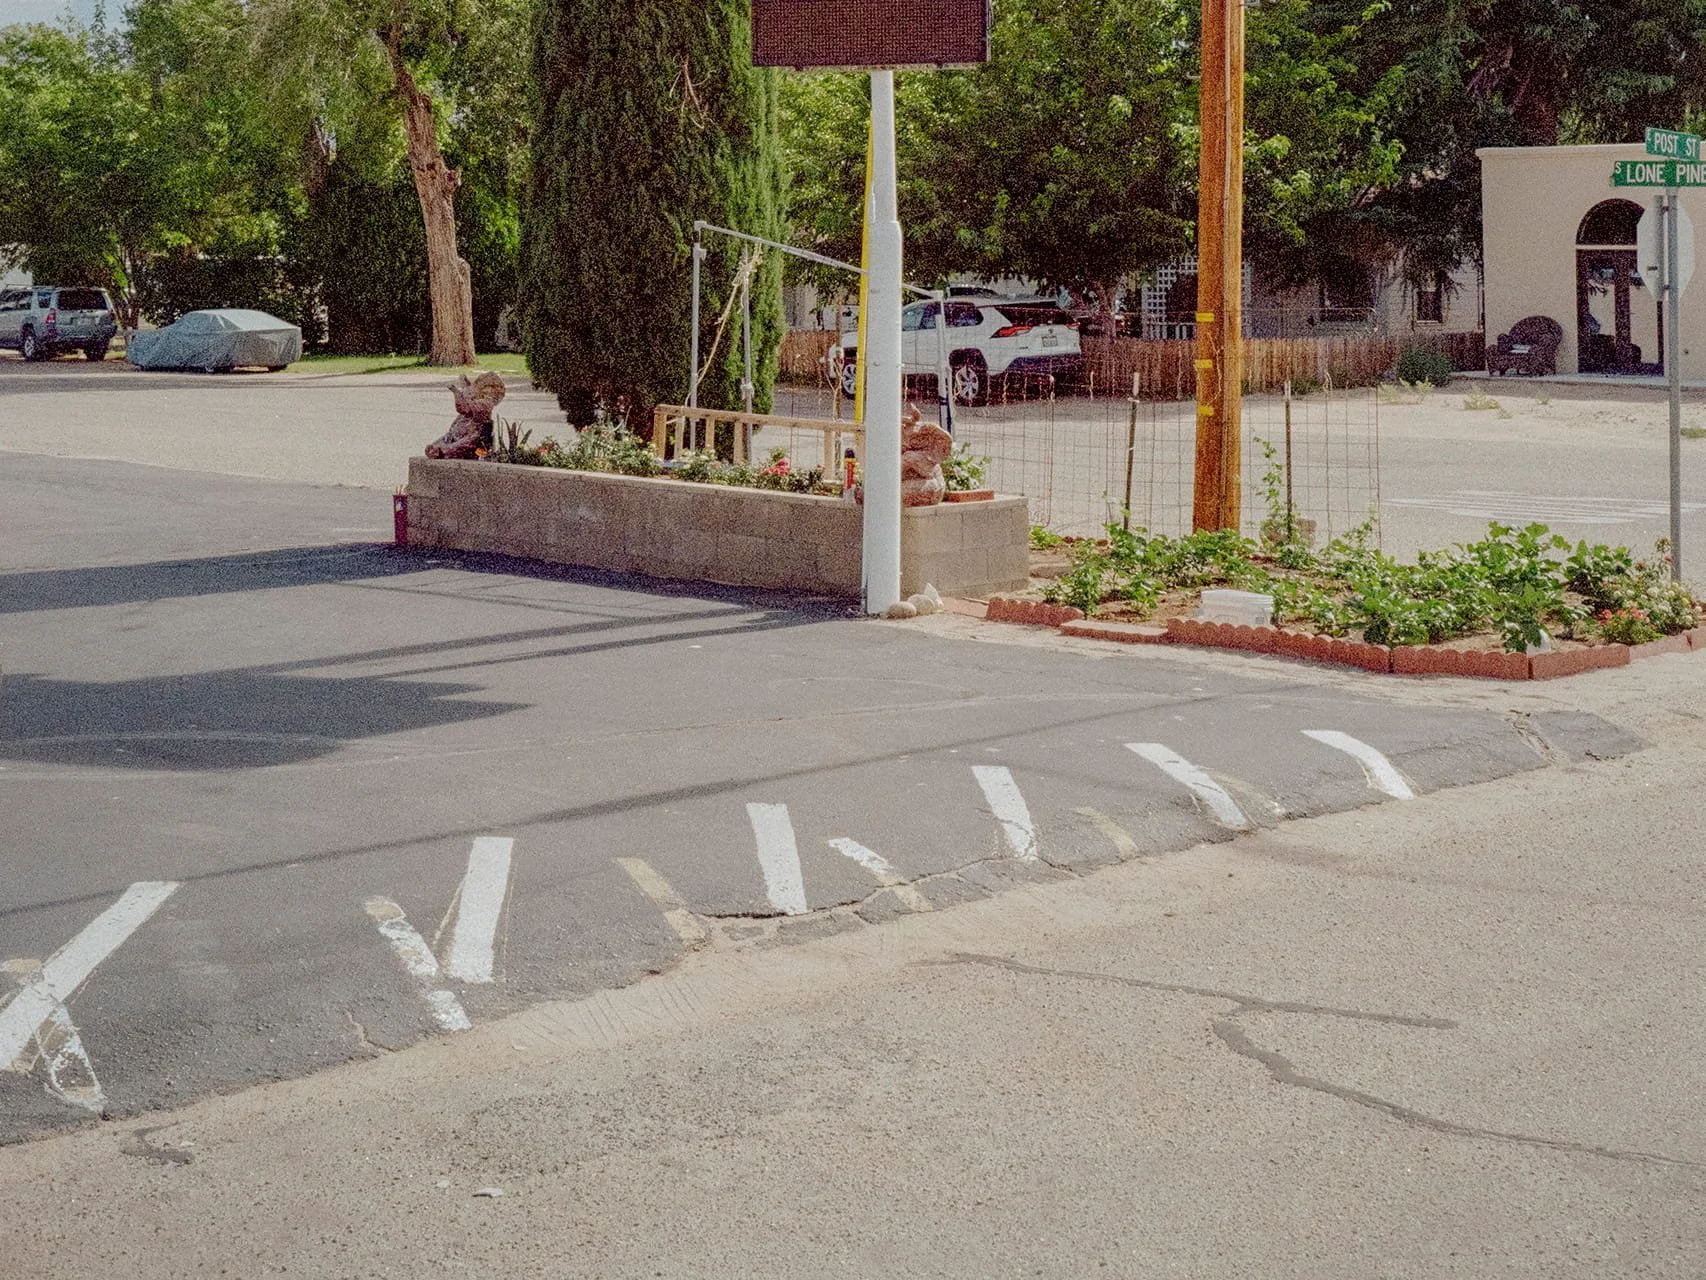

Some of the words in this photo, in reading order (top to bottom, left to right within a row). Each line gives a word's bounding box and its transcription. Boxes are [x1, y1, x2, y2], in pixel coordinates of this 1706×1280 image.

[1654, 132, 1679, 155] POST
[1685, 137, 1697, 157] ST
[1615, 162, 1621, 174] S
[1626, 163, 1666, 183] LONE
[1676, 163, 1706, 183] PINE
